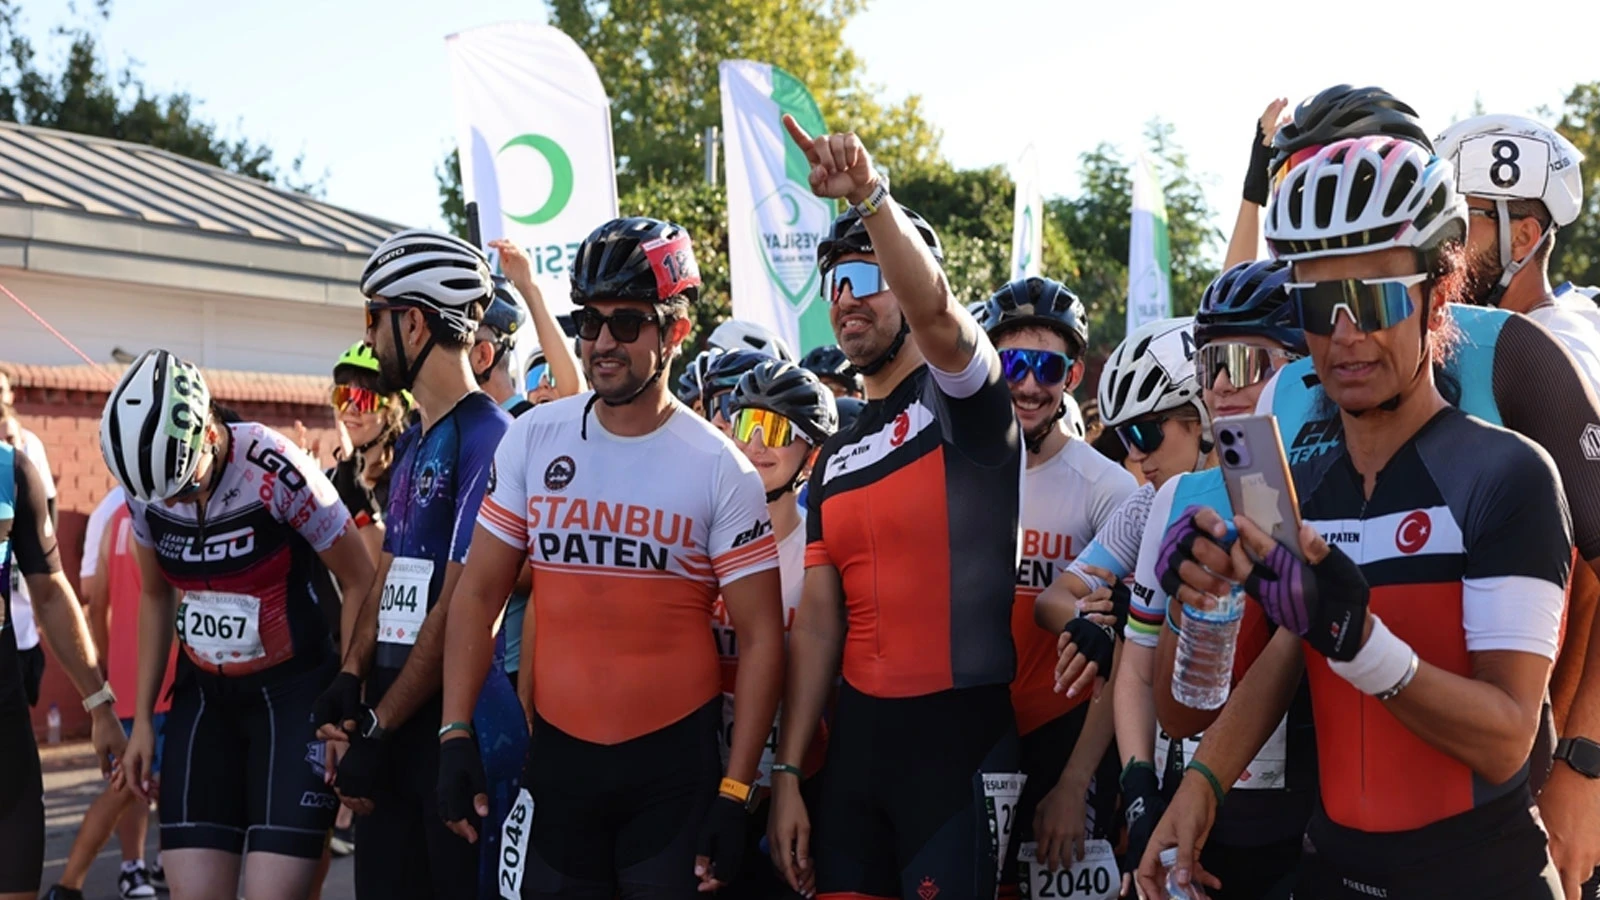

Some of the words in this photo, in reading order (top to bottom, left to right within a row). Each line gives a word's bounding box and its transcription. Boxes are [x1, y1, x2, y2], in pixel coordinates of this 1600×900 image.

[1489, 139, 1520, 188] 8
[527, 495, 697, 549] STANBUL
[1330, 532, 1361, 543] PATEN
[182, 526, 255, 562] LGO
[539, 532, 669, 570] PATEN
[191, 612, 247, 639] 2067
[501, 804, 527, 891] 2048
[1038, 866, 1110, 898] 2040
